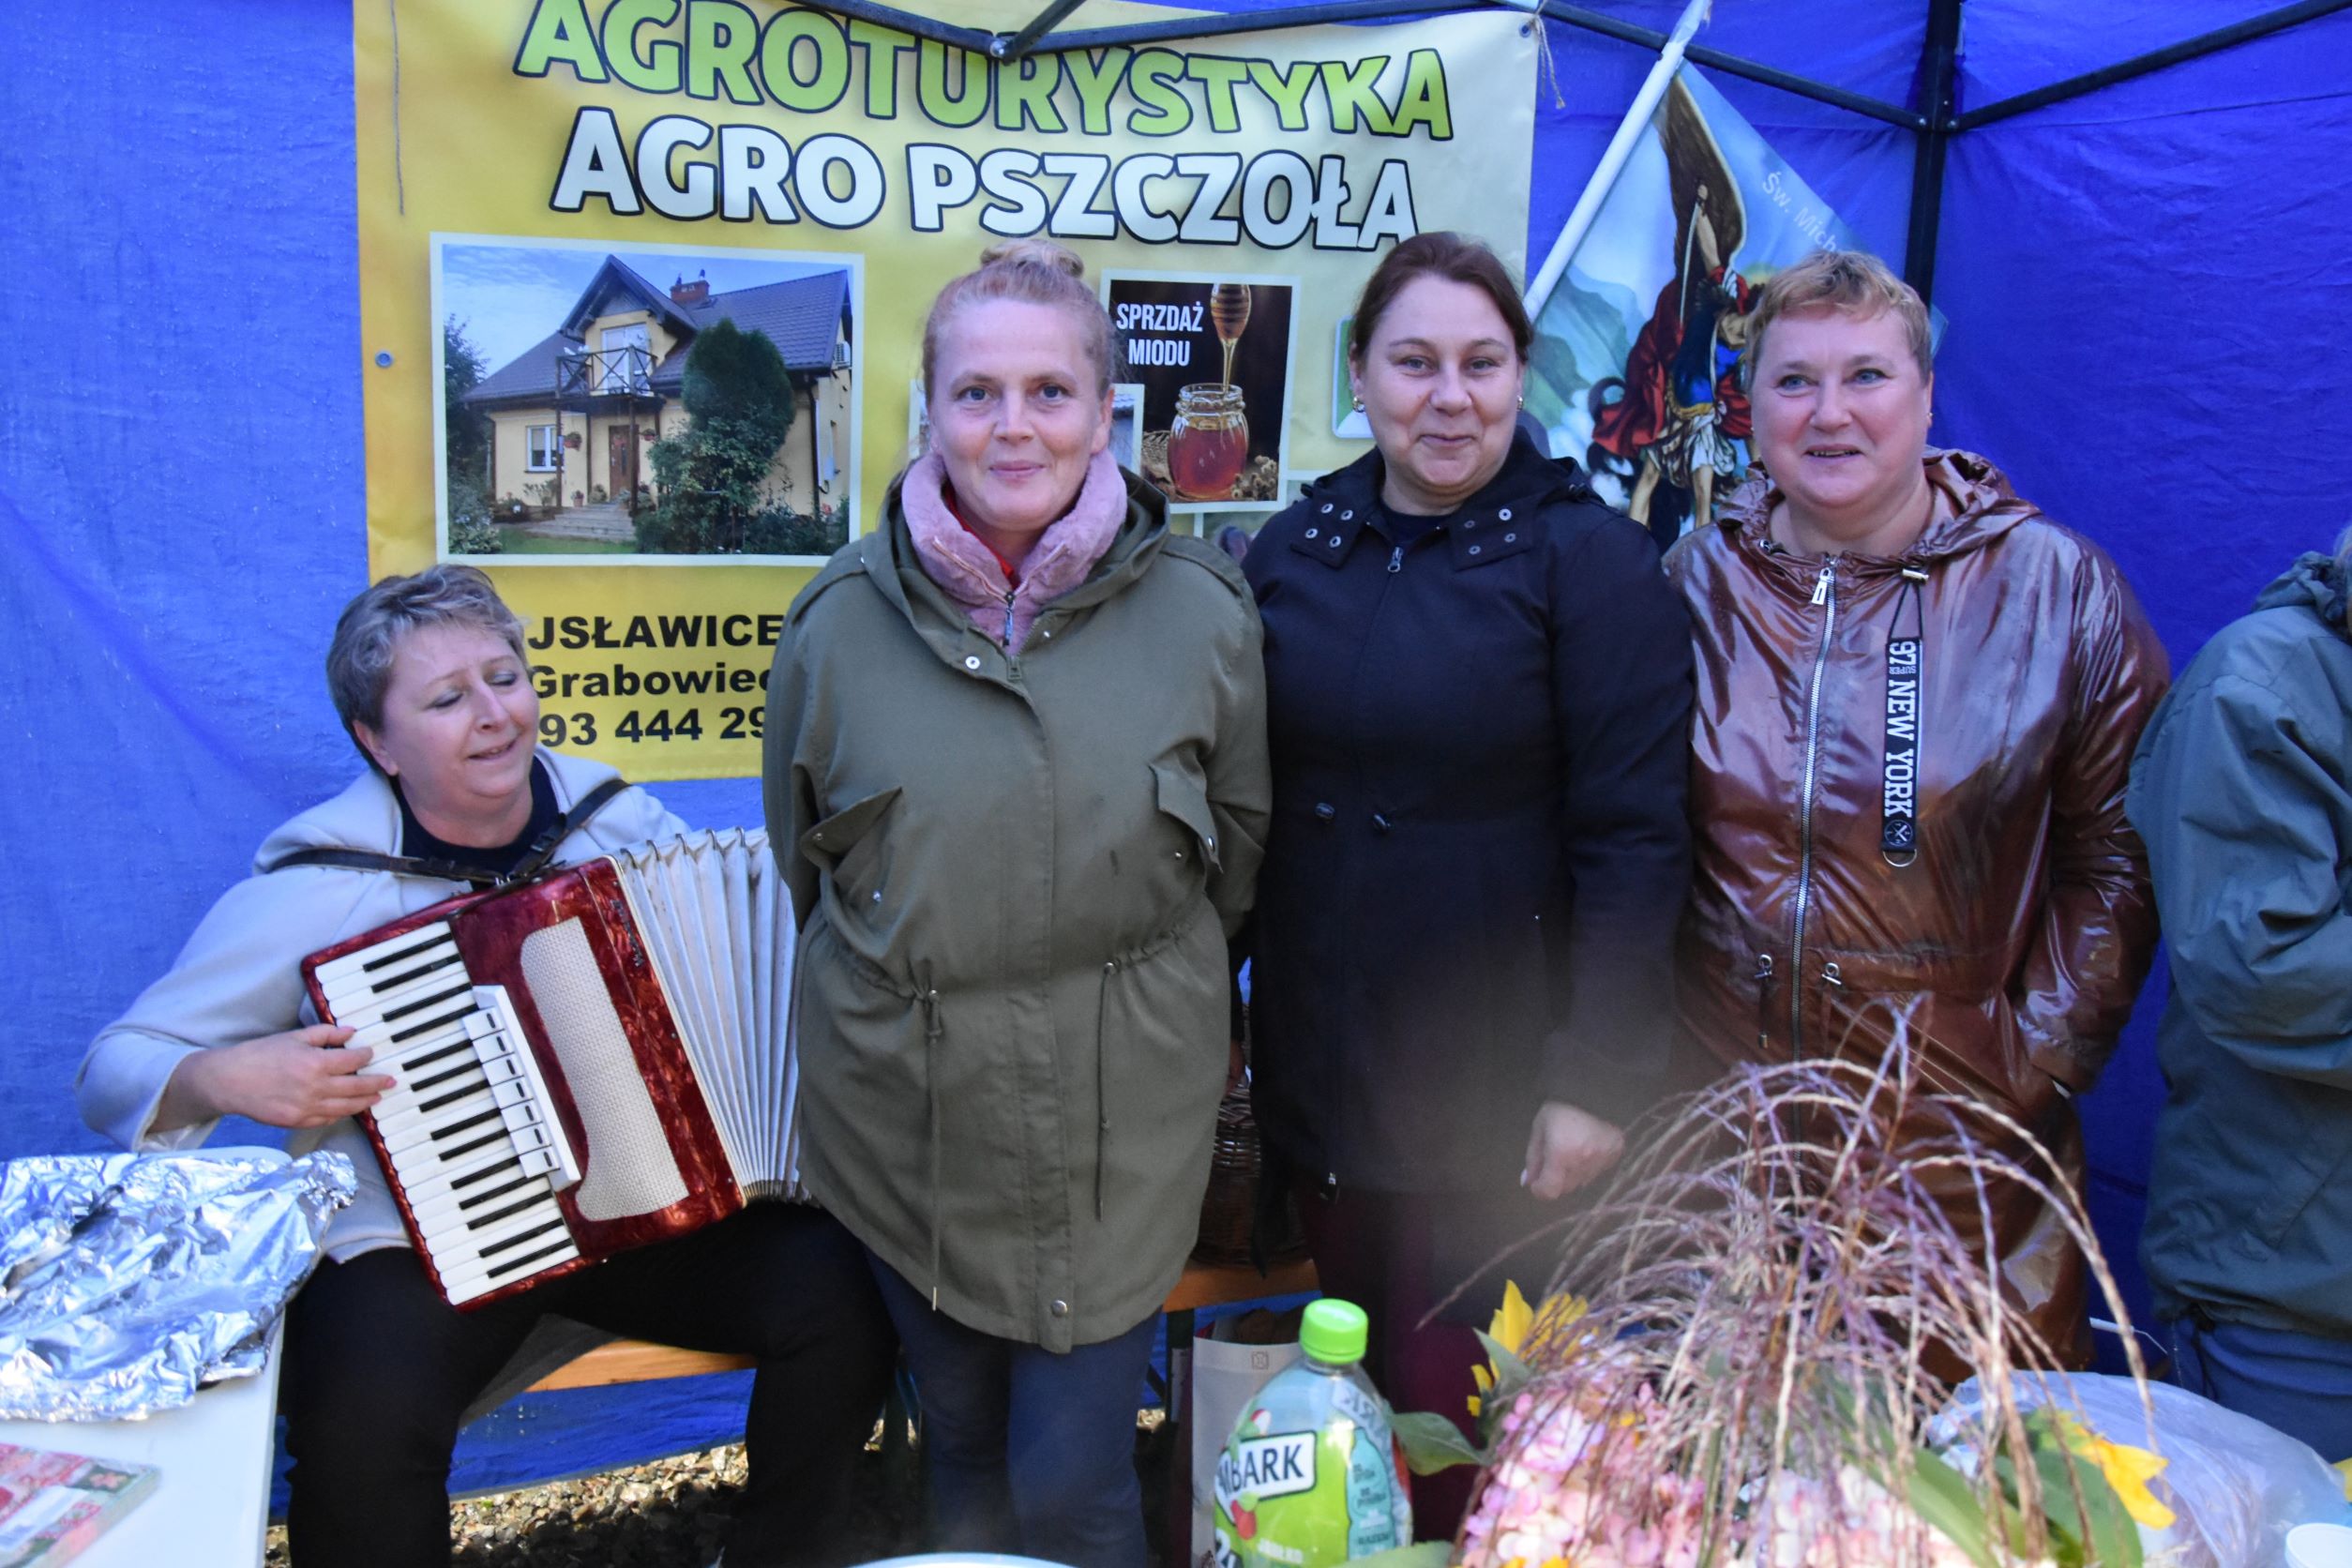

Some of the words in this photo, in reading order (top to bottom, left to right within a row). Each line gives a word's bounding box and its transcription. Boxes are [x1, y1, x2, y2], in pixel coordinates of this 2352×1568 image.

[513, 0, 1454, 141] AGROTURYSTYKA
[549, 105, 886, 230] AGRO
[905, 143, 1419, 251] PSZCZOŁA
[1762, 171, 1791, 214] Św.
[1116, 300, 1204, 332] SPRZDAŻ
[1128, 339, 1191, 367] MIODU
[528, 614, 785, 650] JSŁAWICE
[1889, 641, 1917, 665] 97
[614, 708, 703, 743] 444
[1886, 679, 1916, 742] NEW
[1884, 748, 1913, 817] YORK
